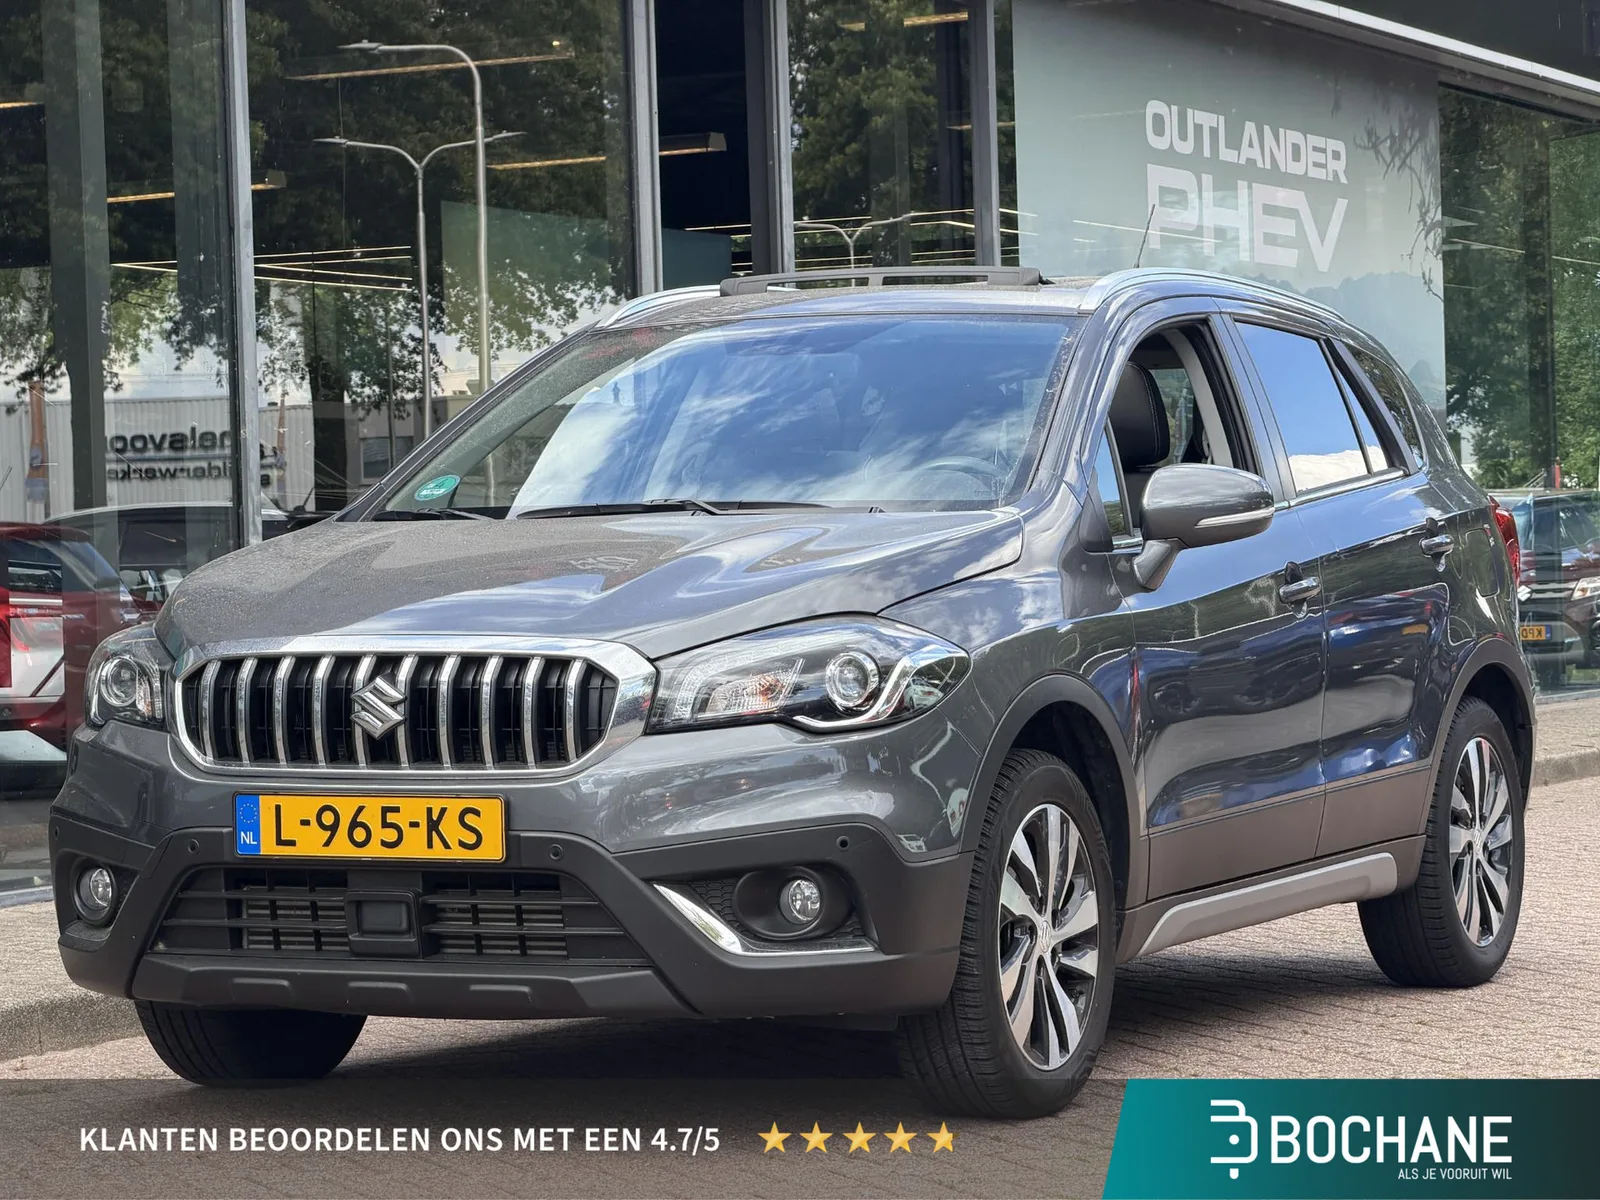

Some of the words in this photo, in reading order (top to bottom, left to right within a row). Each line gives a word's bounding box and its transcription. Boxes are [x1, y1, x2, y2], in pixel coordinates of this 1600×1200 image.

[1145, 99, 1348, 184] OUTLANDER
[1146, 163, 1349, 272] PHEV
[240, 831, 258, 845] NL
[274, 803, 484, 851] L-965-KS
